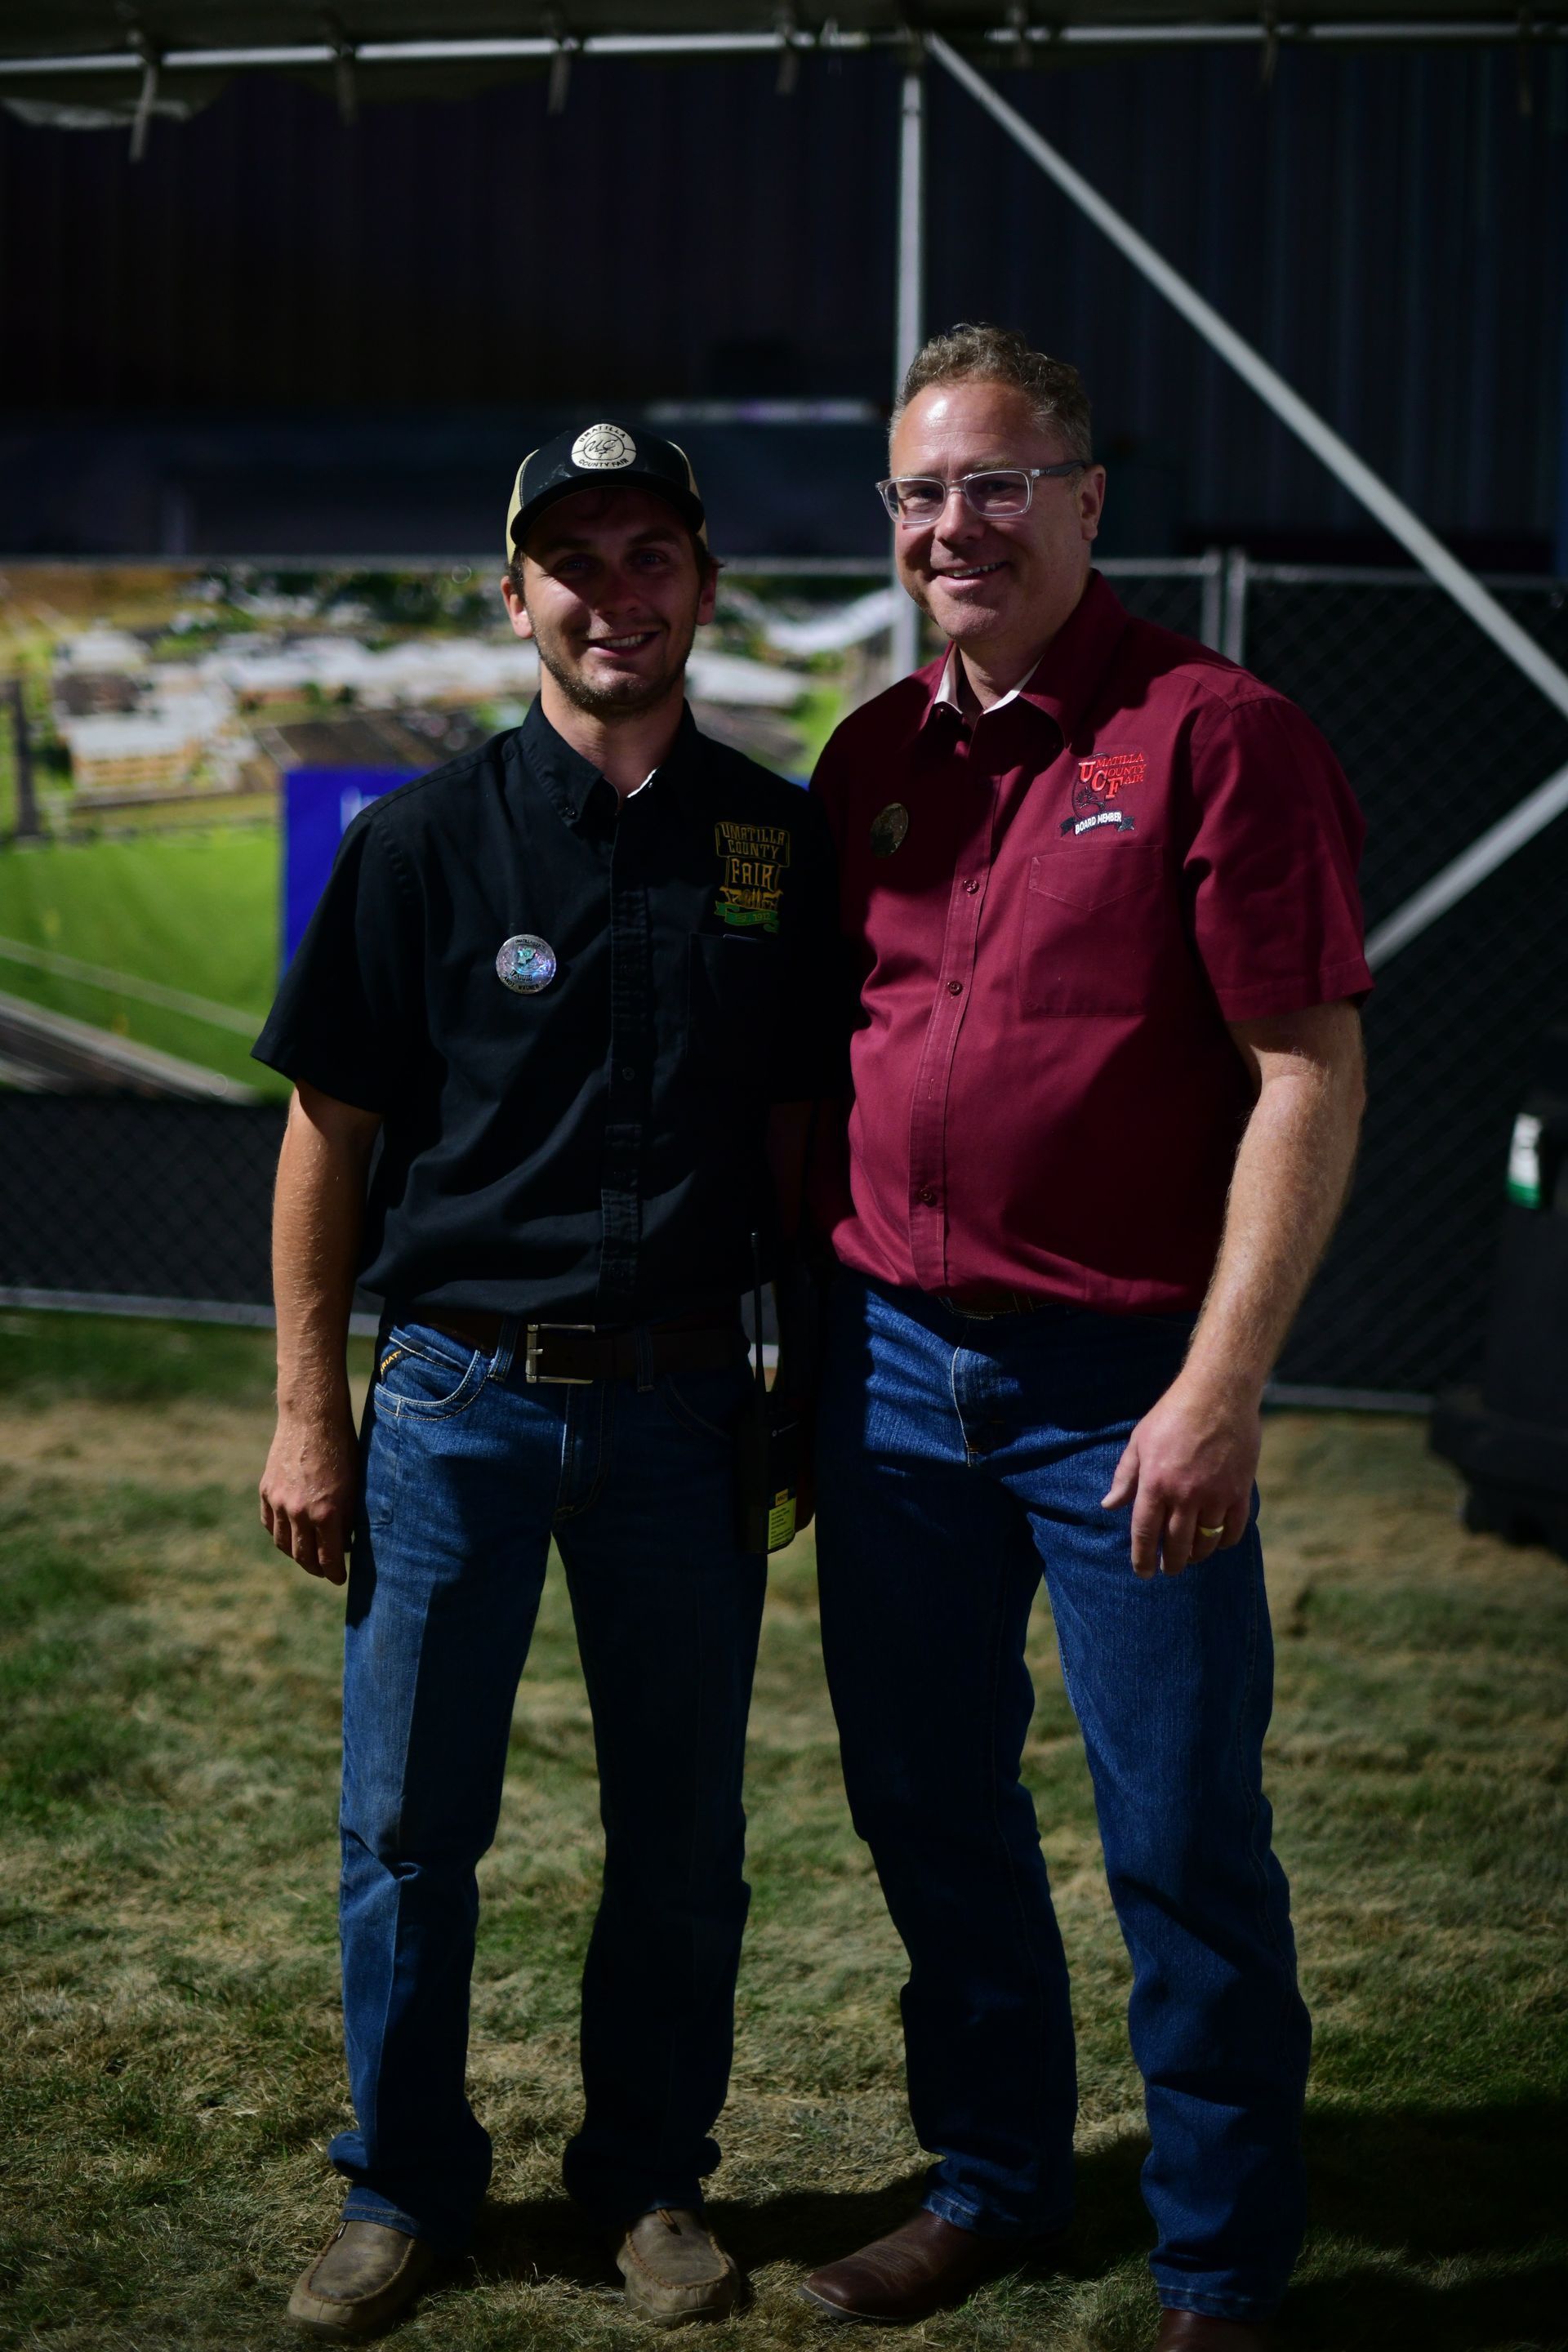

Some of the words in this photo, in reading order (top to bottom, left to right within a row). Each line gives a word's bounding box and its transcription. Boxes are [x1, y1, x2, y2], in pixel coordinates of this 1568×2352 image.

[578, 425, 626, 443] UMATILLA
[578, 459, 608, 467] COUNTY
[612, 458, 629, 467] FAIR
[1078, 753, 1144, 783] UMATILLA
[1091, 764, 1147, 792] COUNTY
[1105, 774, 1144, 800] FAIR
[721, 823, 785, 846] UMATILLA
[1075, 816, 1097, 835] BOARD
[1098, 811, 1122, 823] MEMBER
[728, 840, 781, 860] COUNTY
[731, 858, 776, 892] FAIR
[752, 913, 772, 922] 1912
